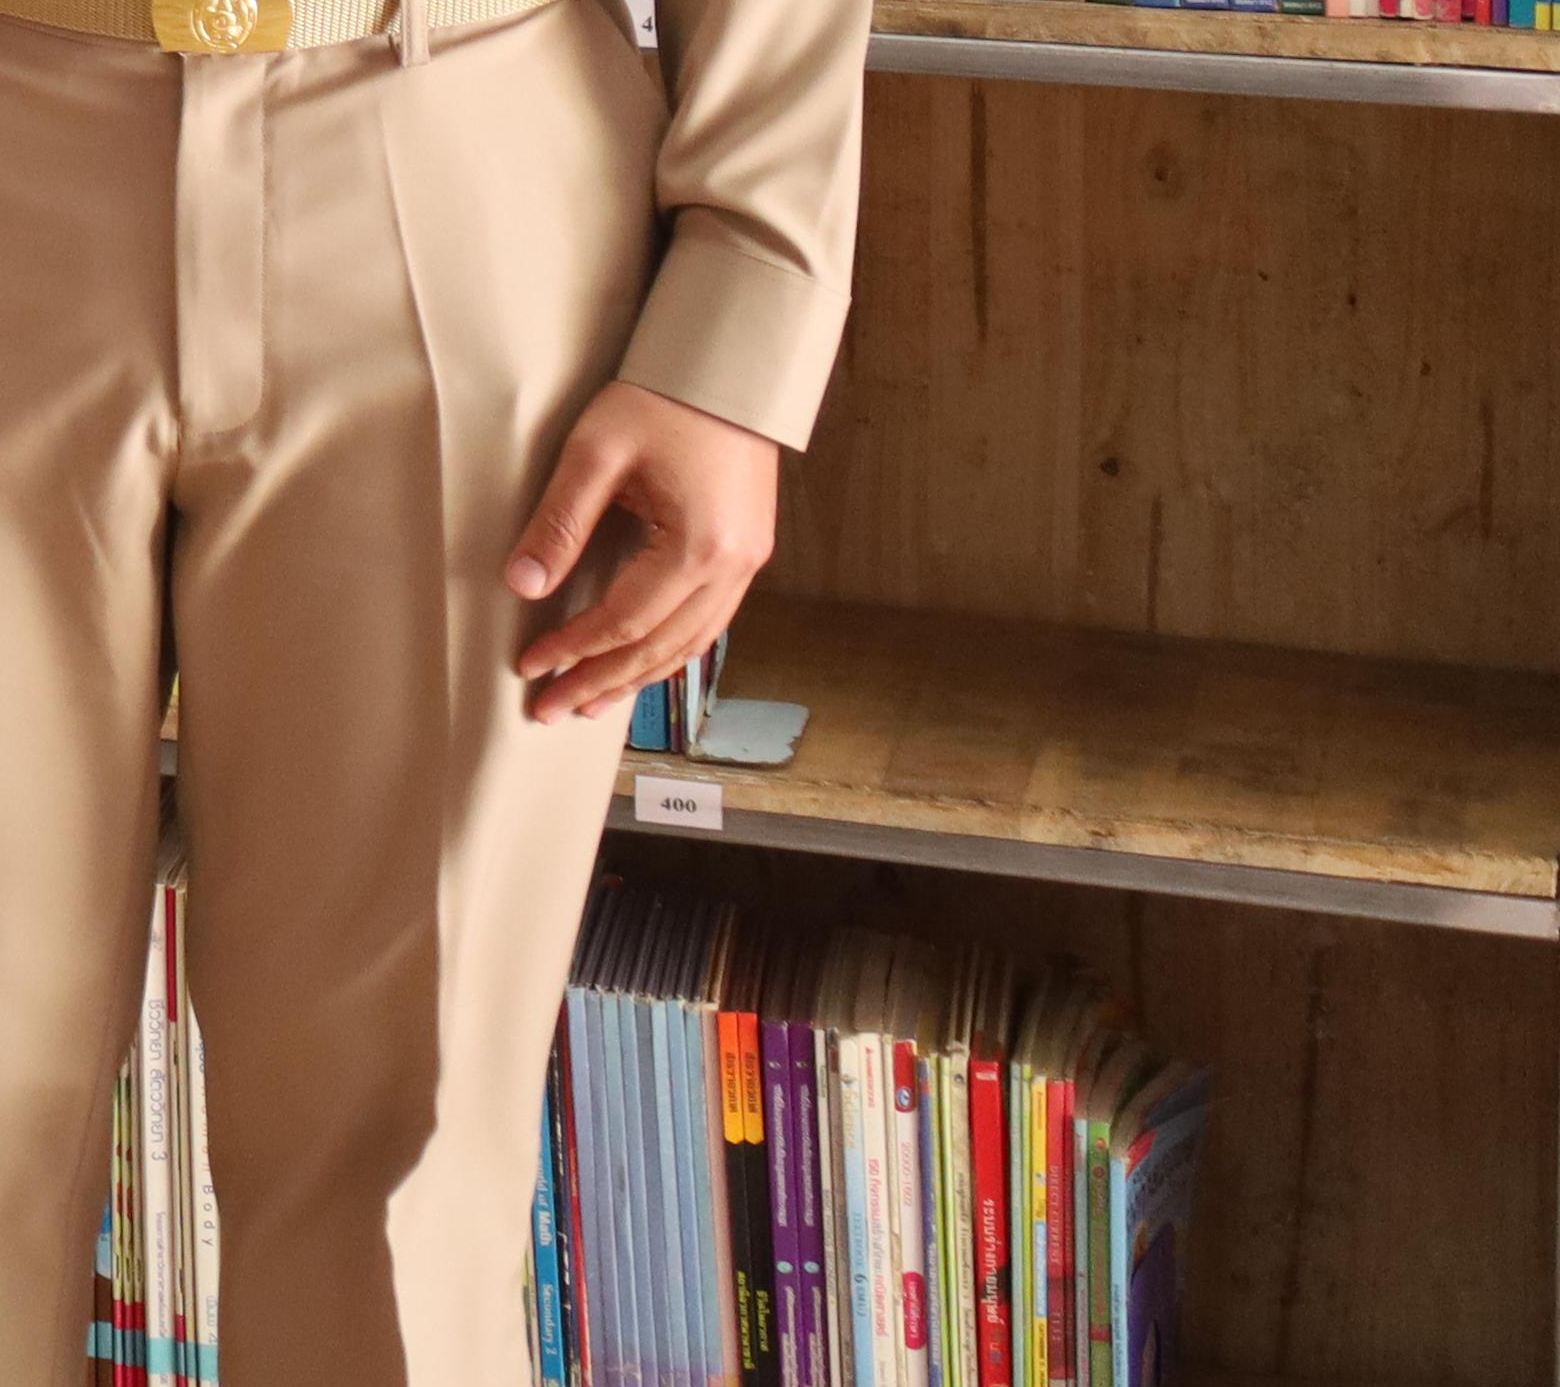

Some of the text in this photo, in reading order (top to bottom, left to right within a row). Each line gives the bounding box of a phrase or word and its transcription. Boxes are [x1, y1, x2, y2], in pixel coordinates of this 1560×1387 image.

[660, 797, 696, 814] 400
[148, 999, 167, 1161] ชีววิทยา สัตววิทยา 3
[201, 1185, 215, 1248] Body
[538, 1211, 552, 1245] Math
[854, 1273, 869, 1284] 6
[981, 1199, 1005, 1325] ระบบร่างกายมนุษย์
[541, 1283, 558, 1343] Secondary
[546, 1347, 560, 1355] 2
